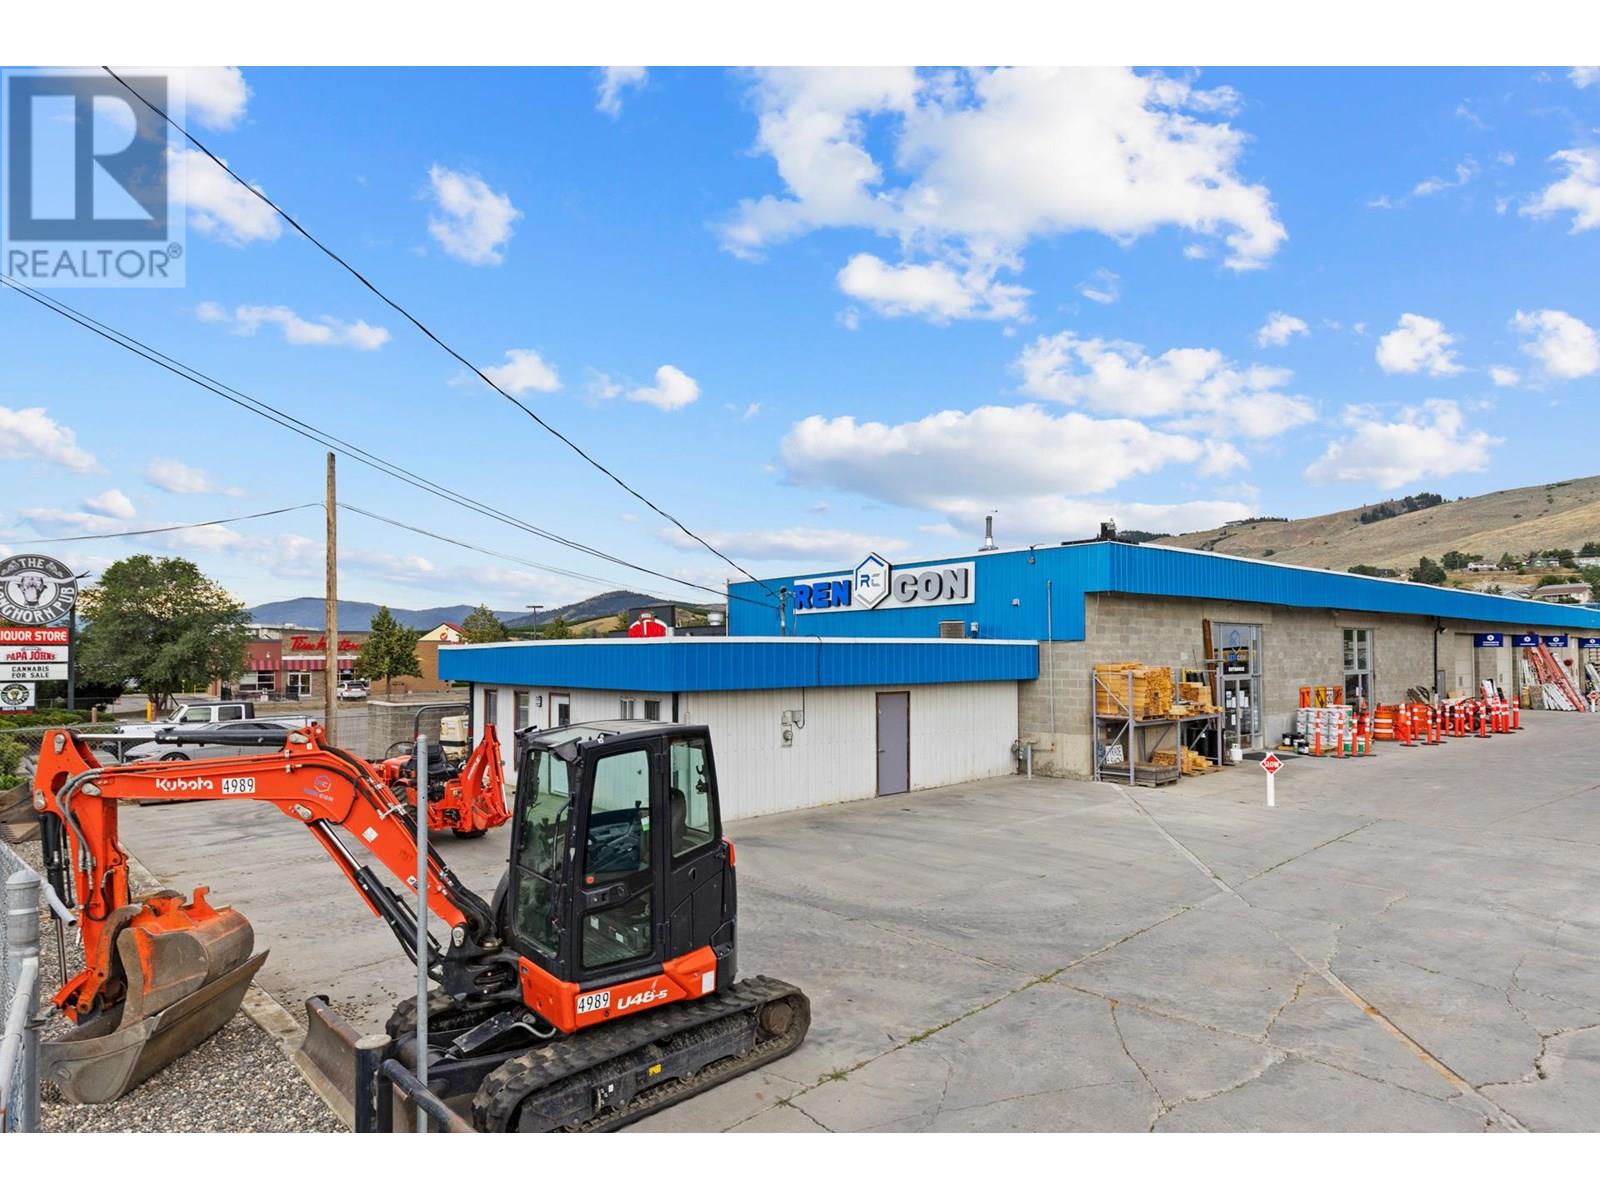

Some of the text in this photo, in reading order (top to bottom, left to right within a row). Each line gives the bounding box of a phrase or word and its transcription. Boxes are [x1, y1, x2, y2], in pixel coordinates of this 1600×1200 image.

[18, 558, 45, 568] THE
[860, 573, 882, 588] RC
[794, 567, 969, 610] REN CON
[53, 587, 75, 612] PUB
[0, 630, 67, 641] IQUOR STORE
[6, 652, 27, 660] PAPA
[155, 777, 254, 793] Kubota 4989
[578, 992, 609, 1012] 4989
